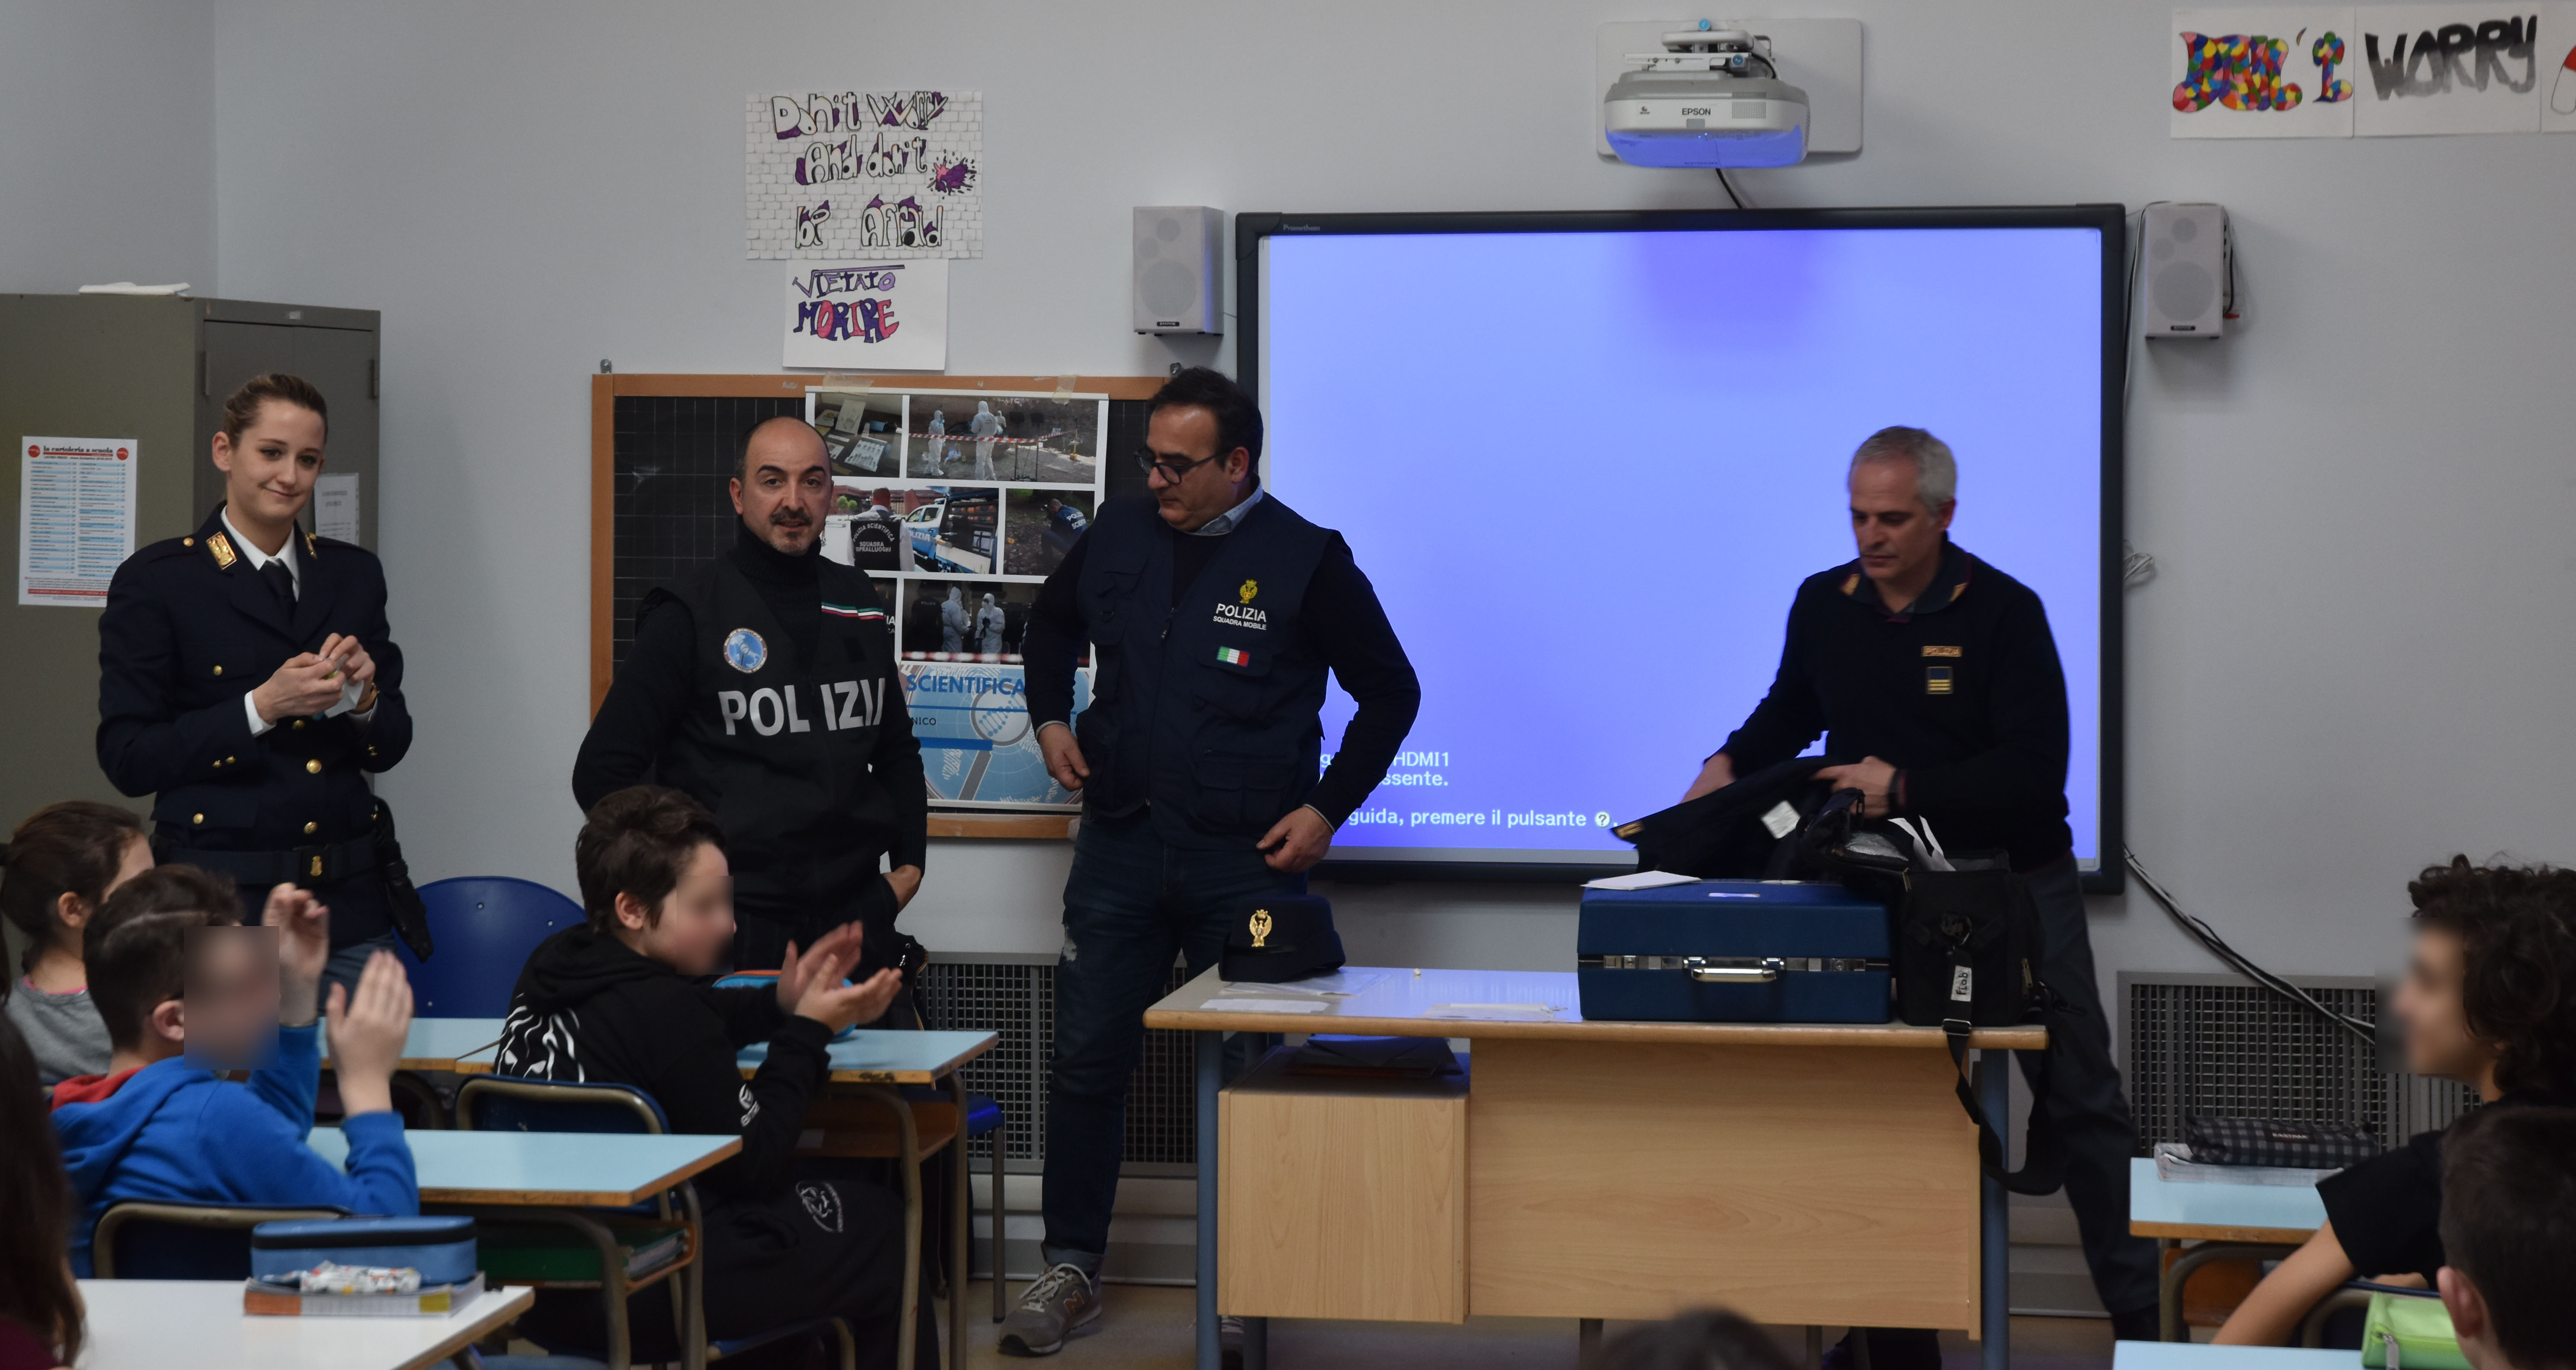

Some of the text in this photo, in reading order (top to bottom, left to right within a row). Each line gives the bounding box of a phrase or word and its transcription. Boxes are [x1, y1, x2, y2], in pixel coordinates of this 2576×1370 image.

[793, 298, 899, 343] MORIRE
[867, 523, 895, 541] SCIENTIFICA
[1216, 603, 1267, 622] POLIZIA
[1213, 616, 1267, 630] SQUADRA MOBILE
[906, 675, 1025, 695] SCIENTIFICA
[911, 717, 936, 725] NICO
[1393, 752, 1448, 767] HDMI1
[1381, 771, 1448, 786] ssente.
[1349, 808, 1404, 826] guida,
[1411, 812, 1485, 827] premere
[1491, 809, 1501, 825] il
[1507, 809, 1587, 829] pulsante
